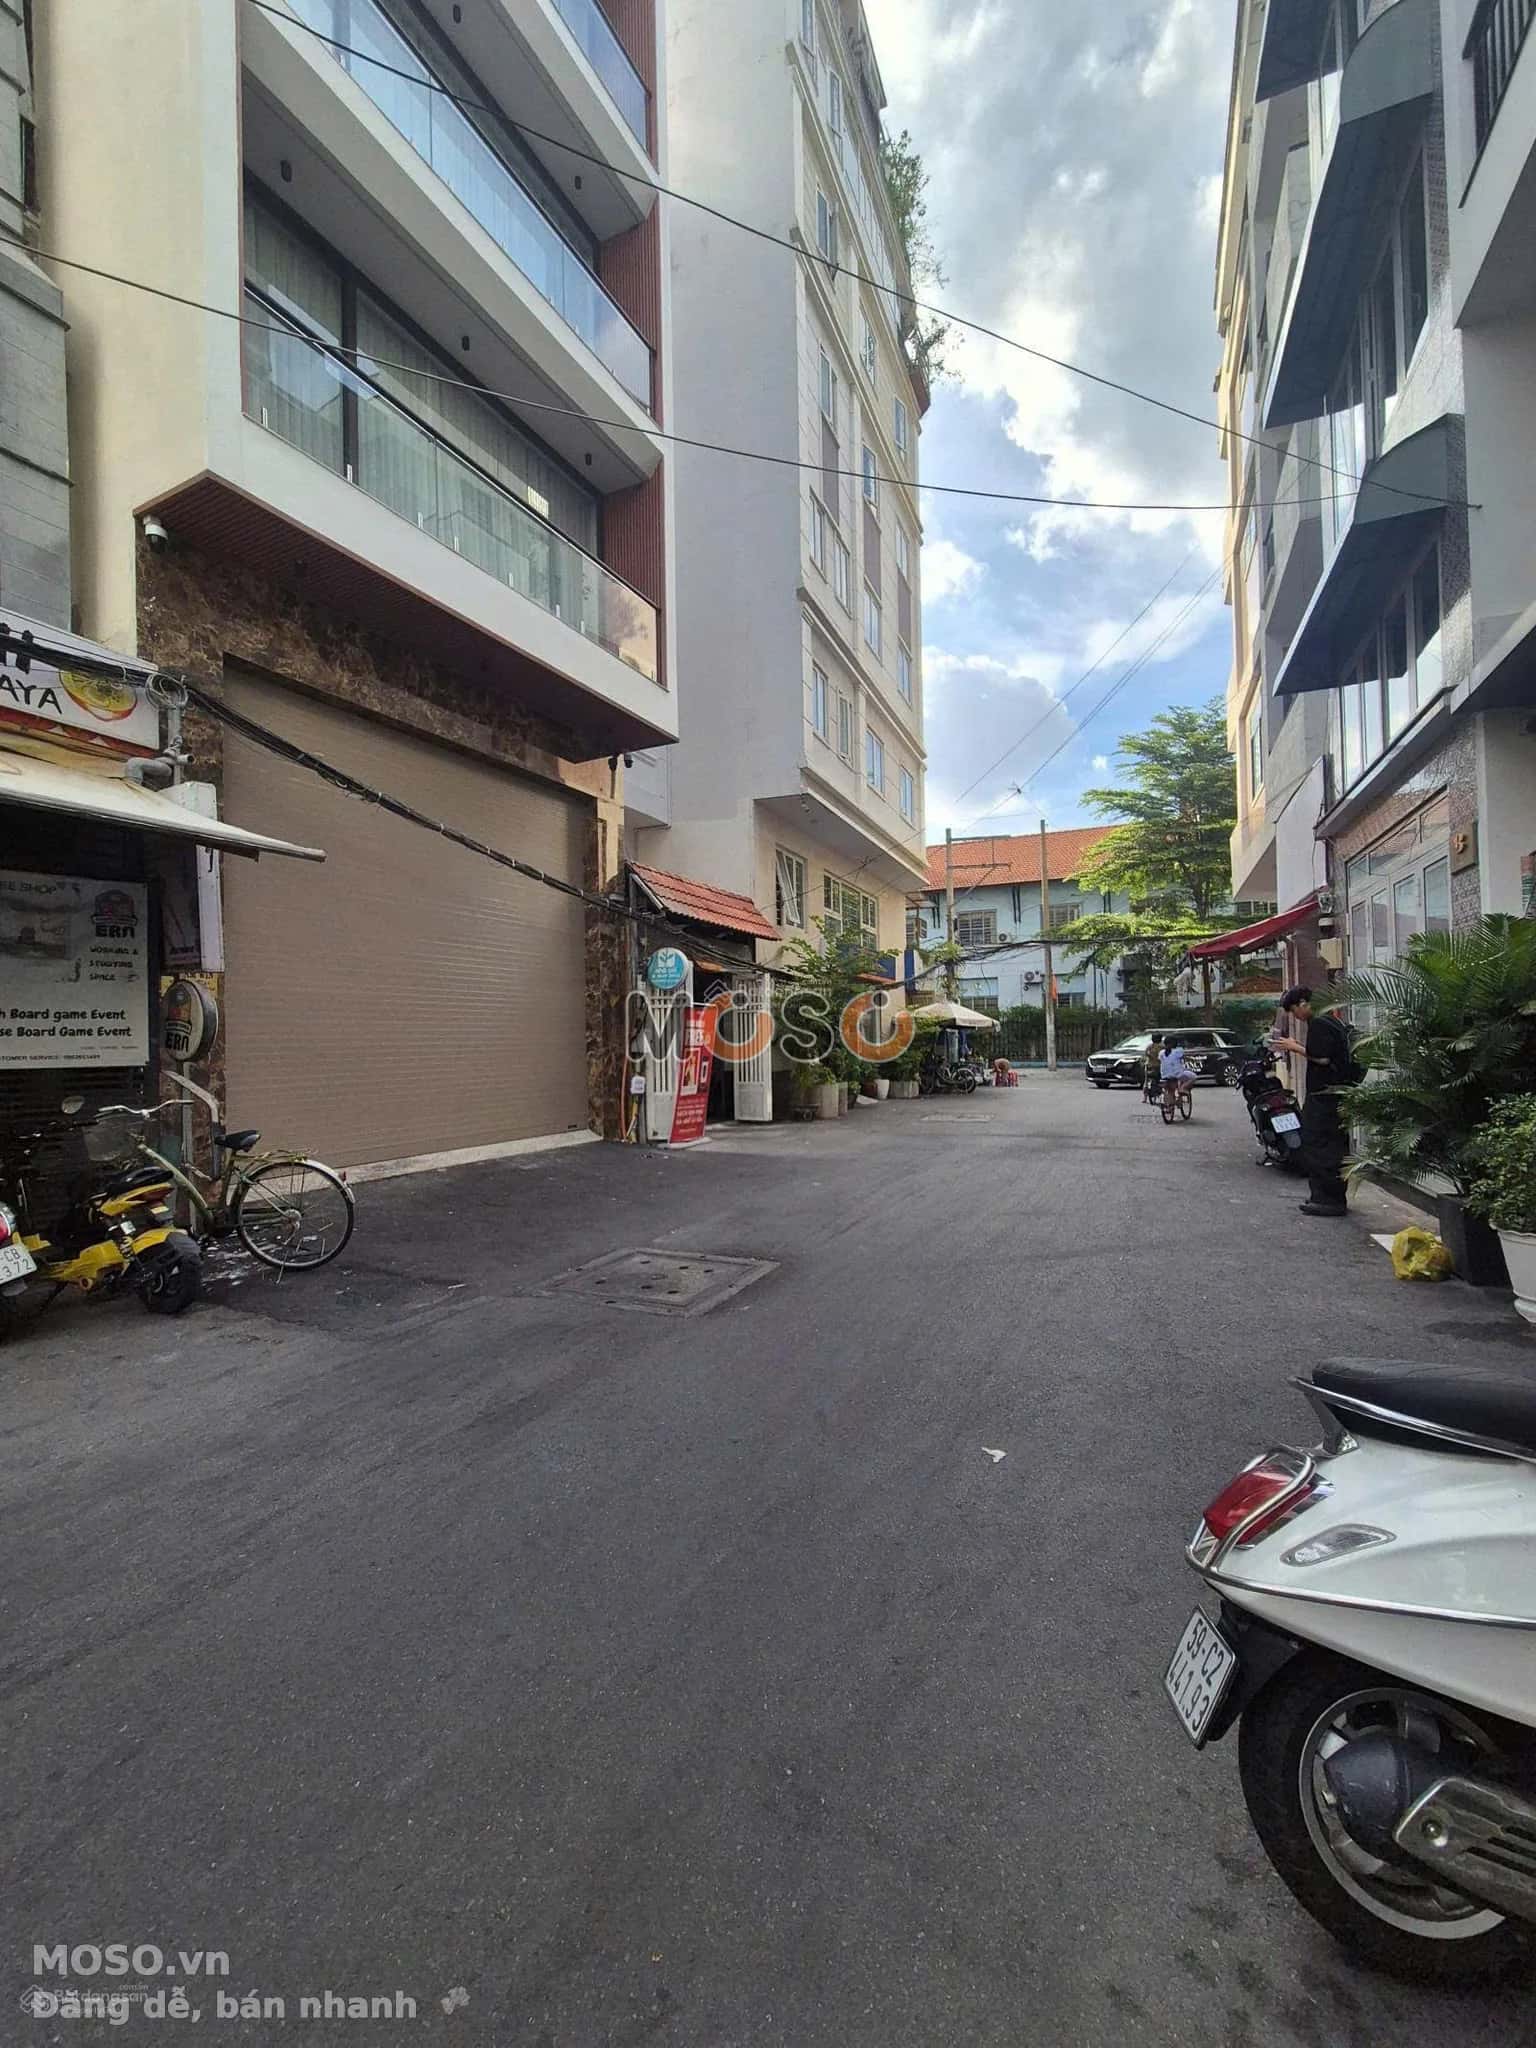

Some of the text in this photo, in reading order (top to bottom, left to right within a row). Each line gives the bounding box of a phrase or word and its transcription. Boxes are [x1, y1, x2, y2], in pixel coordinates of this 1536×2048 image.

[9, 1008, 50, 1020] Board
[53, 1011, 88, 1023] game
[90, 1009, 127, 1020] Event
[16, 1026, 56, 1038] Board
[59, 1026, 94, 1038] Game
[97, 1026, 133, 1038] Event
